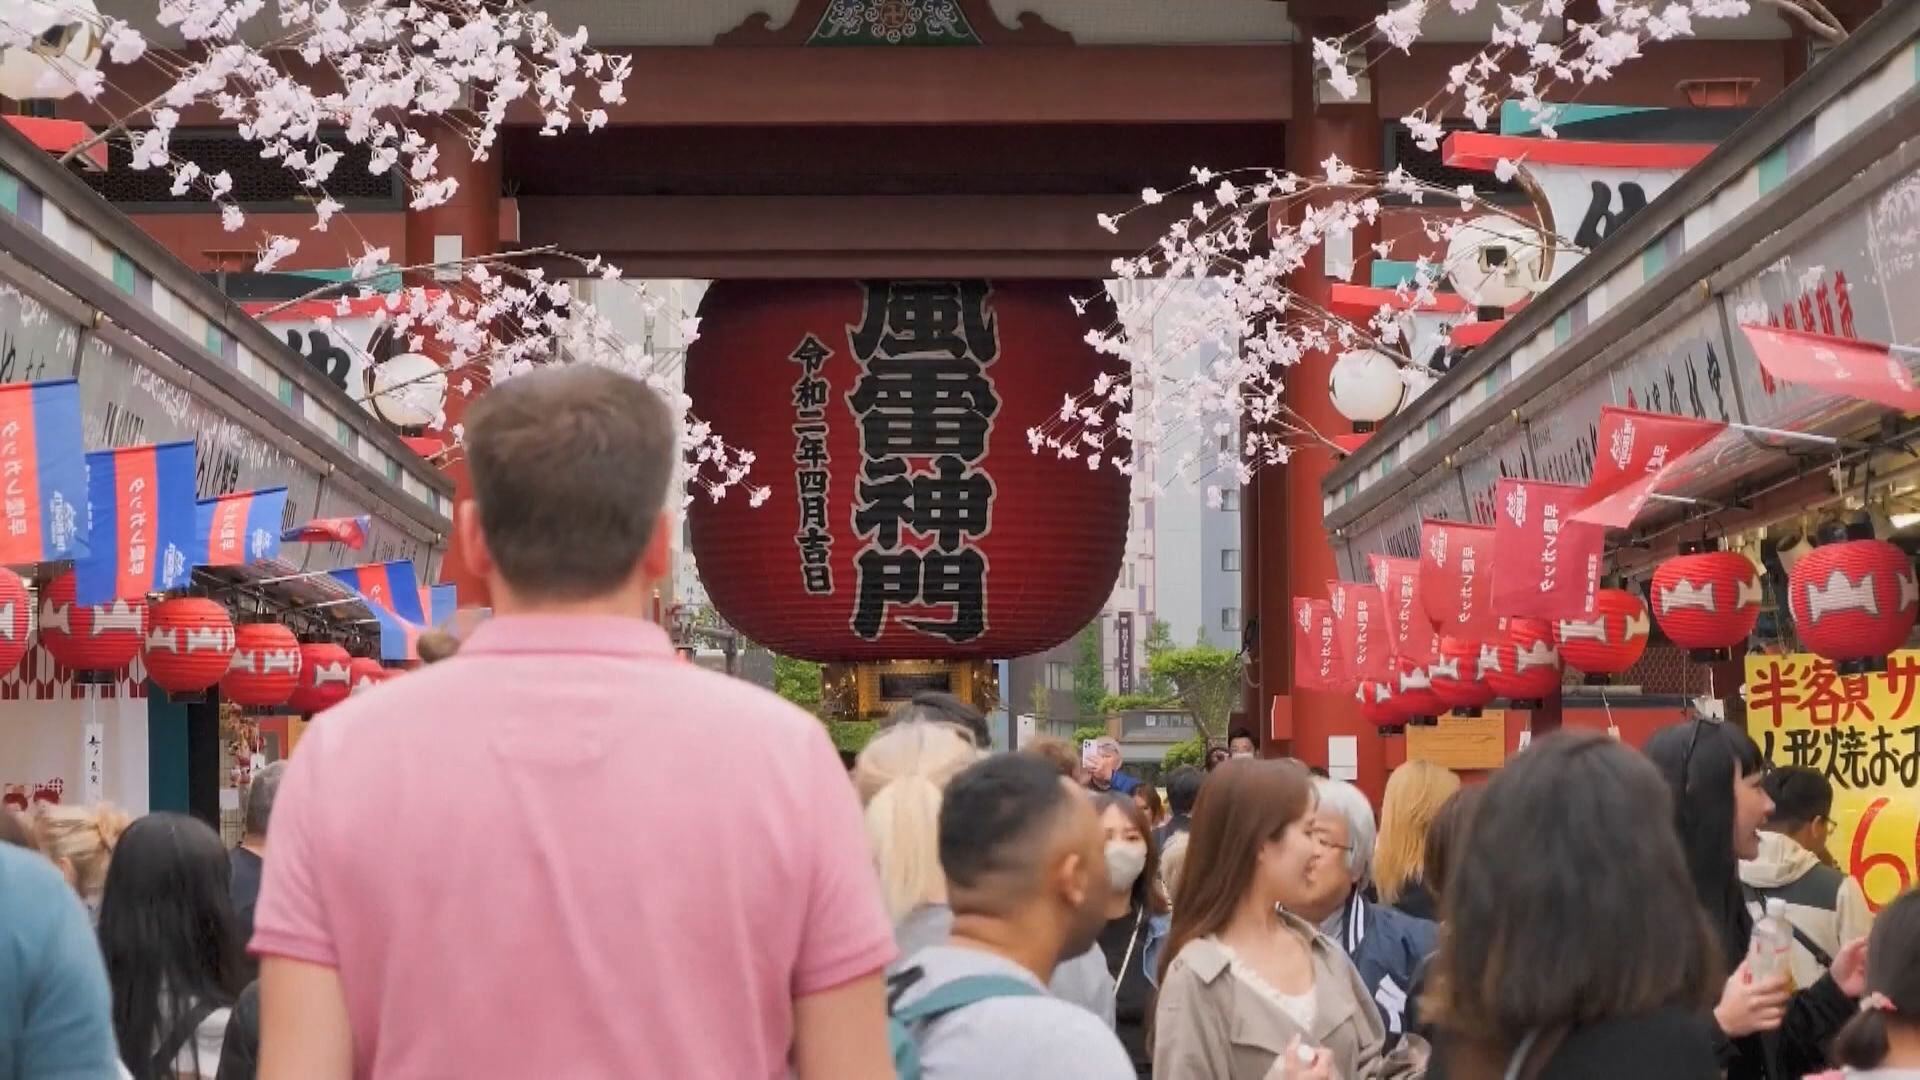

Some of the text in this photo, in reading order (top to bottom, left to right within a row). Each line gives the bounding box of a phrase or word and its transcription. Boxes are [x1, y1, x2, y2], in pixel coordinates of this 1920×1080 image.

[789, 333, 835, 595] 令和二年四月吉日
[845, 280, 1001, 643] 風雷神門
